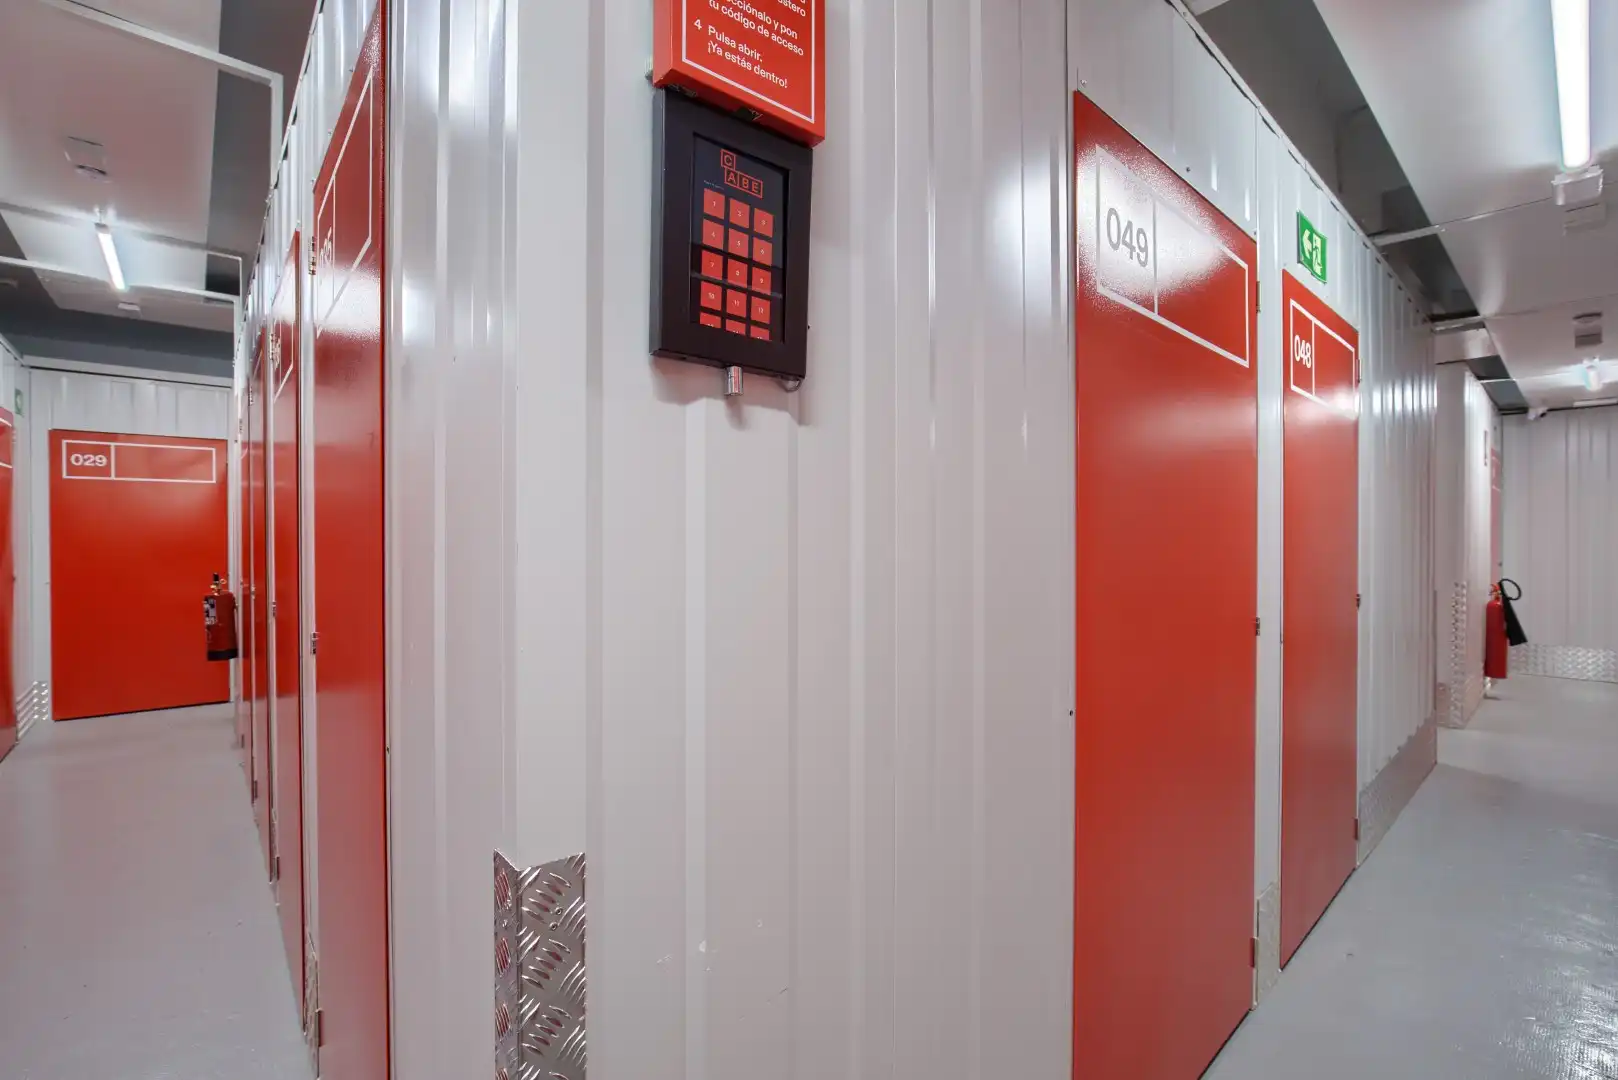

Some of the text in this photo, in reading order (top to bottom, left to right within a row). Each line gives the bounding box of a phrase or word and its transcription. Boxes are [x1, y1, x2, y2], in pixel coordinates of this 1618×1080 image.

[694, 19, 763, 63] 4 Pulsa abrir.
[709, 0, 804, 56] tu código de acceso
[727, 0, 798, 39] cciónalo y pon
[707, 40, 788, 88] ¡Ya estás dentro!
[1106, 207, 1148, 268] 049
[1294, 334, 1312, 369] 048
[70, 453, 107, 467] 029
